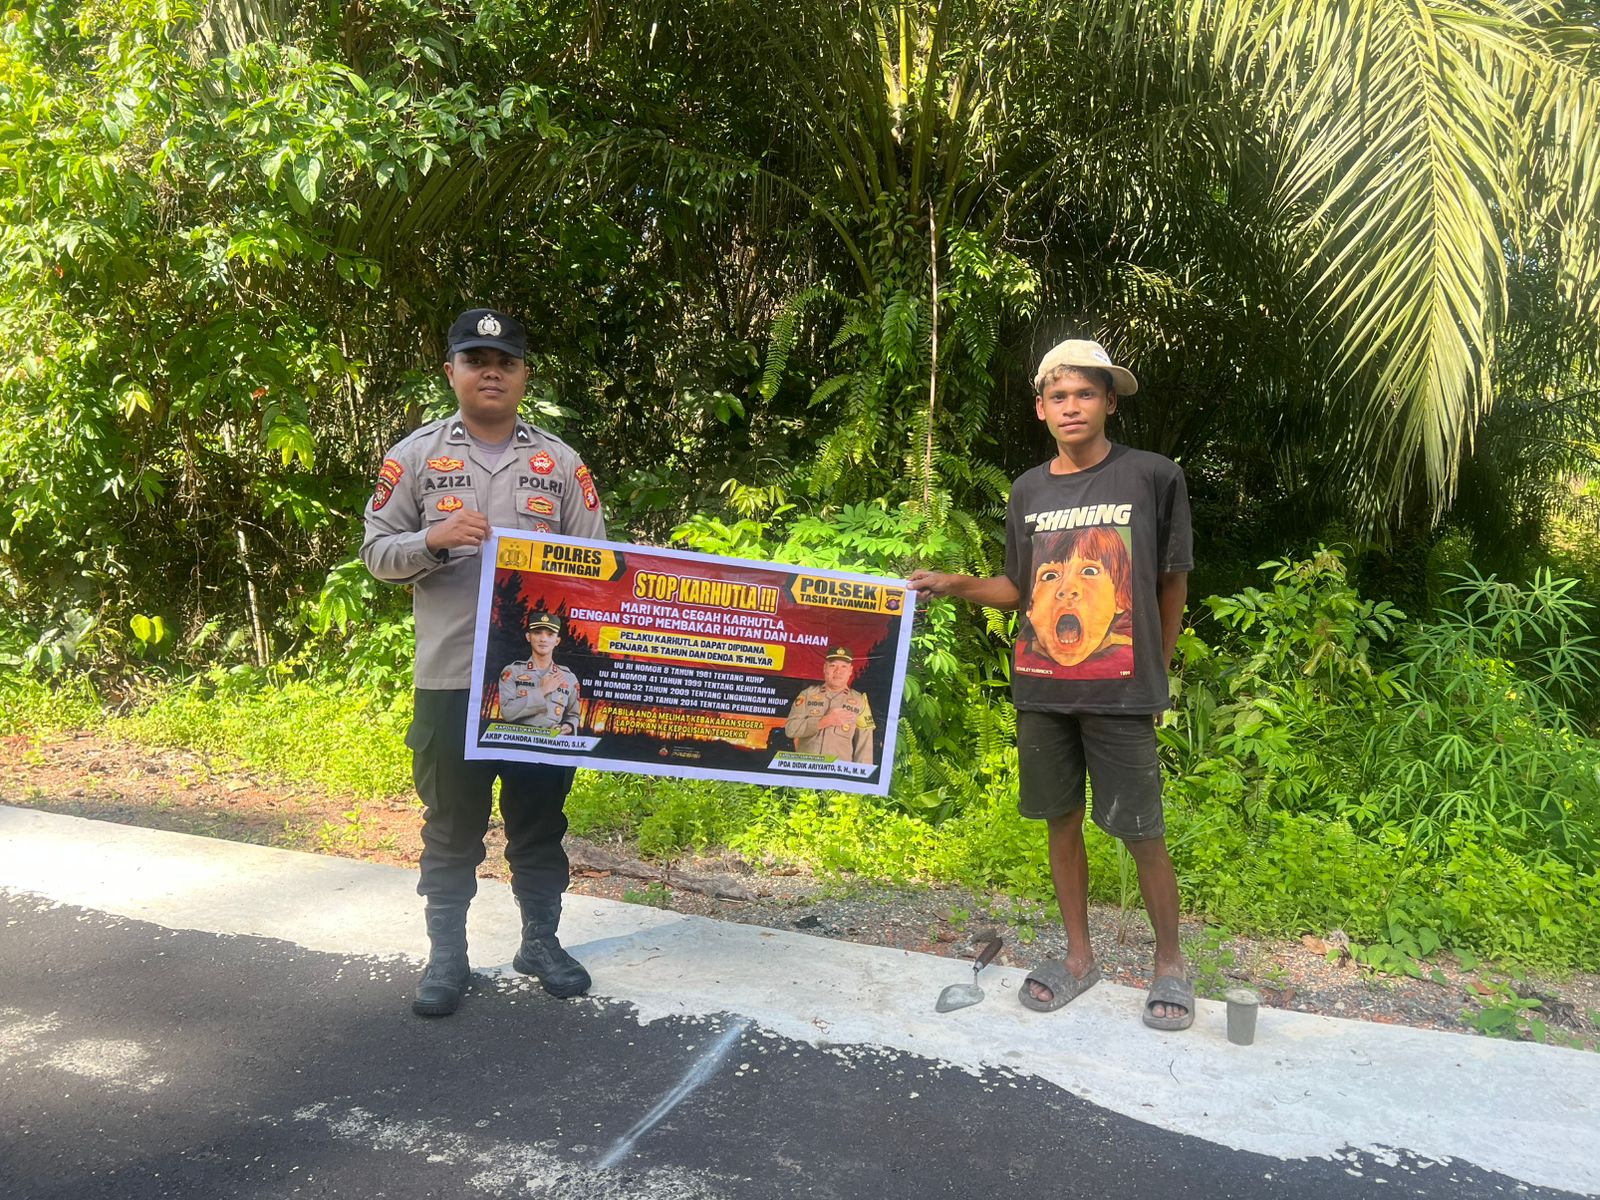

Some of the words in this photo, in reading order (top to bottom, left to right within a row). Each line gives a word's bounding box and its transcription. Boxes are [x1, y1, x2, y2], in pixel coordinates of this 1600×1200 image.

[424, 474, 471, 490] AZIZI
[518, 475, 562, 494] POLRI
[542, 544, 602, 565] POLRES
[541, 560, 601, 577] KATINGAN
[634, 571, 678, 601] STOP
[678, 577, 759, 611] KARHUTLA
[759, 587, 778, 613] !!!
[800, 577, 878, 600] POLSEK
[800, 593, 829, 605] TASIK
[830, 597, 877, 610] PAYAWAN
[570, 608, 620, 623] DENGAN
[622, 614, 653, 627] STOP
[655, 618, 721, 634] MEMBAKAR
[723, 624, 761, 639] HUTAN
[763, 630, 787, 641] DAN
[789, 632, 828, 647] LAHAN
[620, 602, 651, 615] MARI
[653, 605, 680, 618] KITA
[682, 608, 721, 623] CEGAH
[723, 614, 785, 630] KARHUTLA
[609, 641, 649, 653] PENJARA
[651, 646, 659, 654] 15
[661, 647, 688, 657] TAHUN
[689, 650, 706, 660] DAN
[707, 653, 734, 662] DENDA
[735, 655, 744, 663] 15
[744, 656, 773, 666] MILYAR
[620, 631, 655, 643] PELAKU
[655, 634, 699, 648] KARHUTLA
[700, 640, 727, 651] DAPAT
[727, 643, 765, 655] DIPIDANA
[598, 670, 609, 678] UU
[620, 673, 647, 682] NOMOR
[648, 675, 658, 683] 41
[659, 676, 683, 686] TAHUN
[704, 681, 734, 691] TENTANG
[735, 684, 776, 695] KEHUTANAN
[614, 662, 624, 670] UU
[625, 663, 633, 671] RI
[635, 664, 662, 673] NOMOR
[671, 667, 694, 677] TAHUN
[714, 673, 744, 682] TENTANG
[745, 675, 765, 684] KUHP
[594, 680, 602, 688] RI
[603, 681, 631, 690] NOMOR
[632, 684, 643, 692] 32
[645, 685, 669, 694] TAHUN
[670, 687, 690, 696] 2009
[691, 689, 721, 699] TENTANG
[723, 693, 767, 704] LINGKUNGAN
[767, 698, 789, 706] HIDUP
[605, 690, 613, 698] RI
[614, 692, 642, 701] NOMOR
[643, 695, 653, 703] 39
[655, 696, 679, 705] TAHUN
[680, 698, 698, 707] 2014
[700, 700, 730, 710] TENTANG
[731, 704, 776, 714] PERKEBUNAN
[602, 706, 635, 717] APABILA
[635, 710, 657, 719] ANDA
[658, 712, 690, 722] MELIHAT
[690, 715, 736, 727] KEBAKARAN
[737, 720, 764, 729] SEGERA
[616, 719, 657, 730] LAPORKAN
[667, 725, 711, 735] KEPOLISIAN
[711, 728, 749, 738] TERDEKAT
[503, 734, 532, 742] CHANDRA
[778, 760, 791, 768] IPDA
[791, 761, 807, 769] DIDIK
[808, 763, 836, 772] ARIYANTO,
